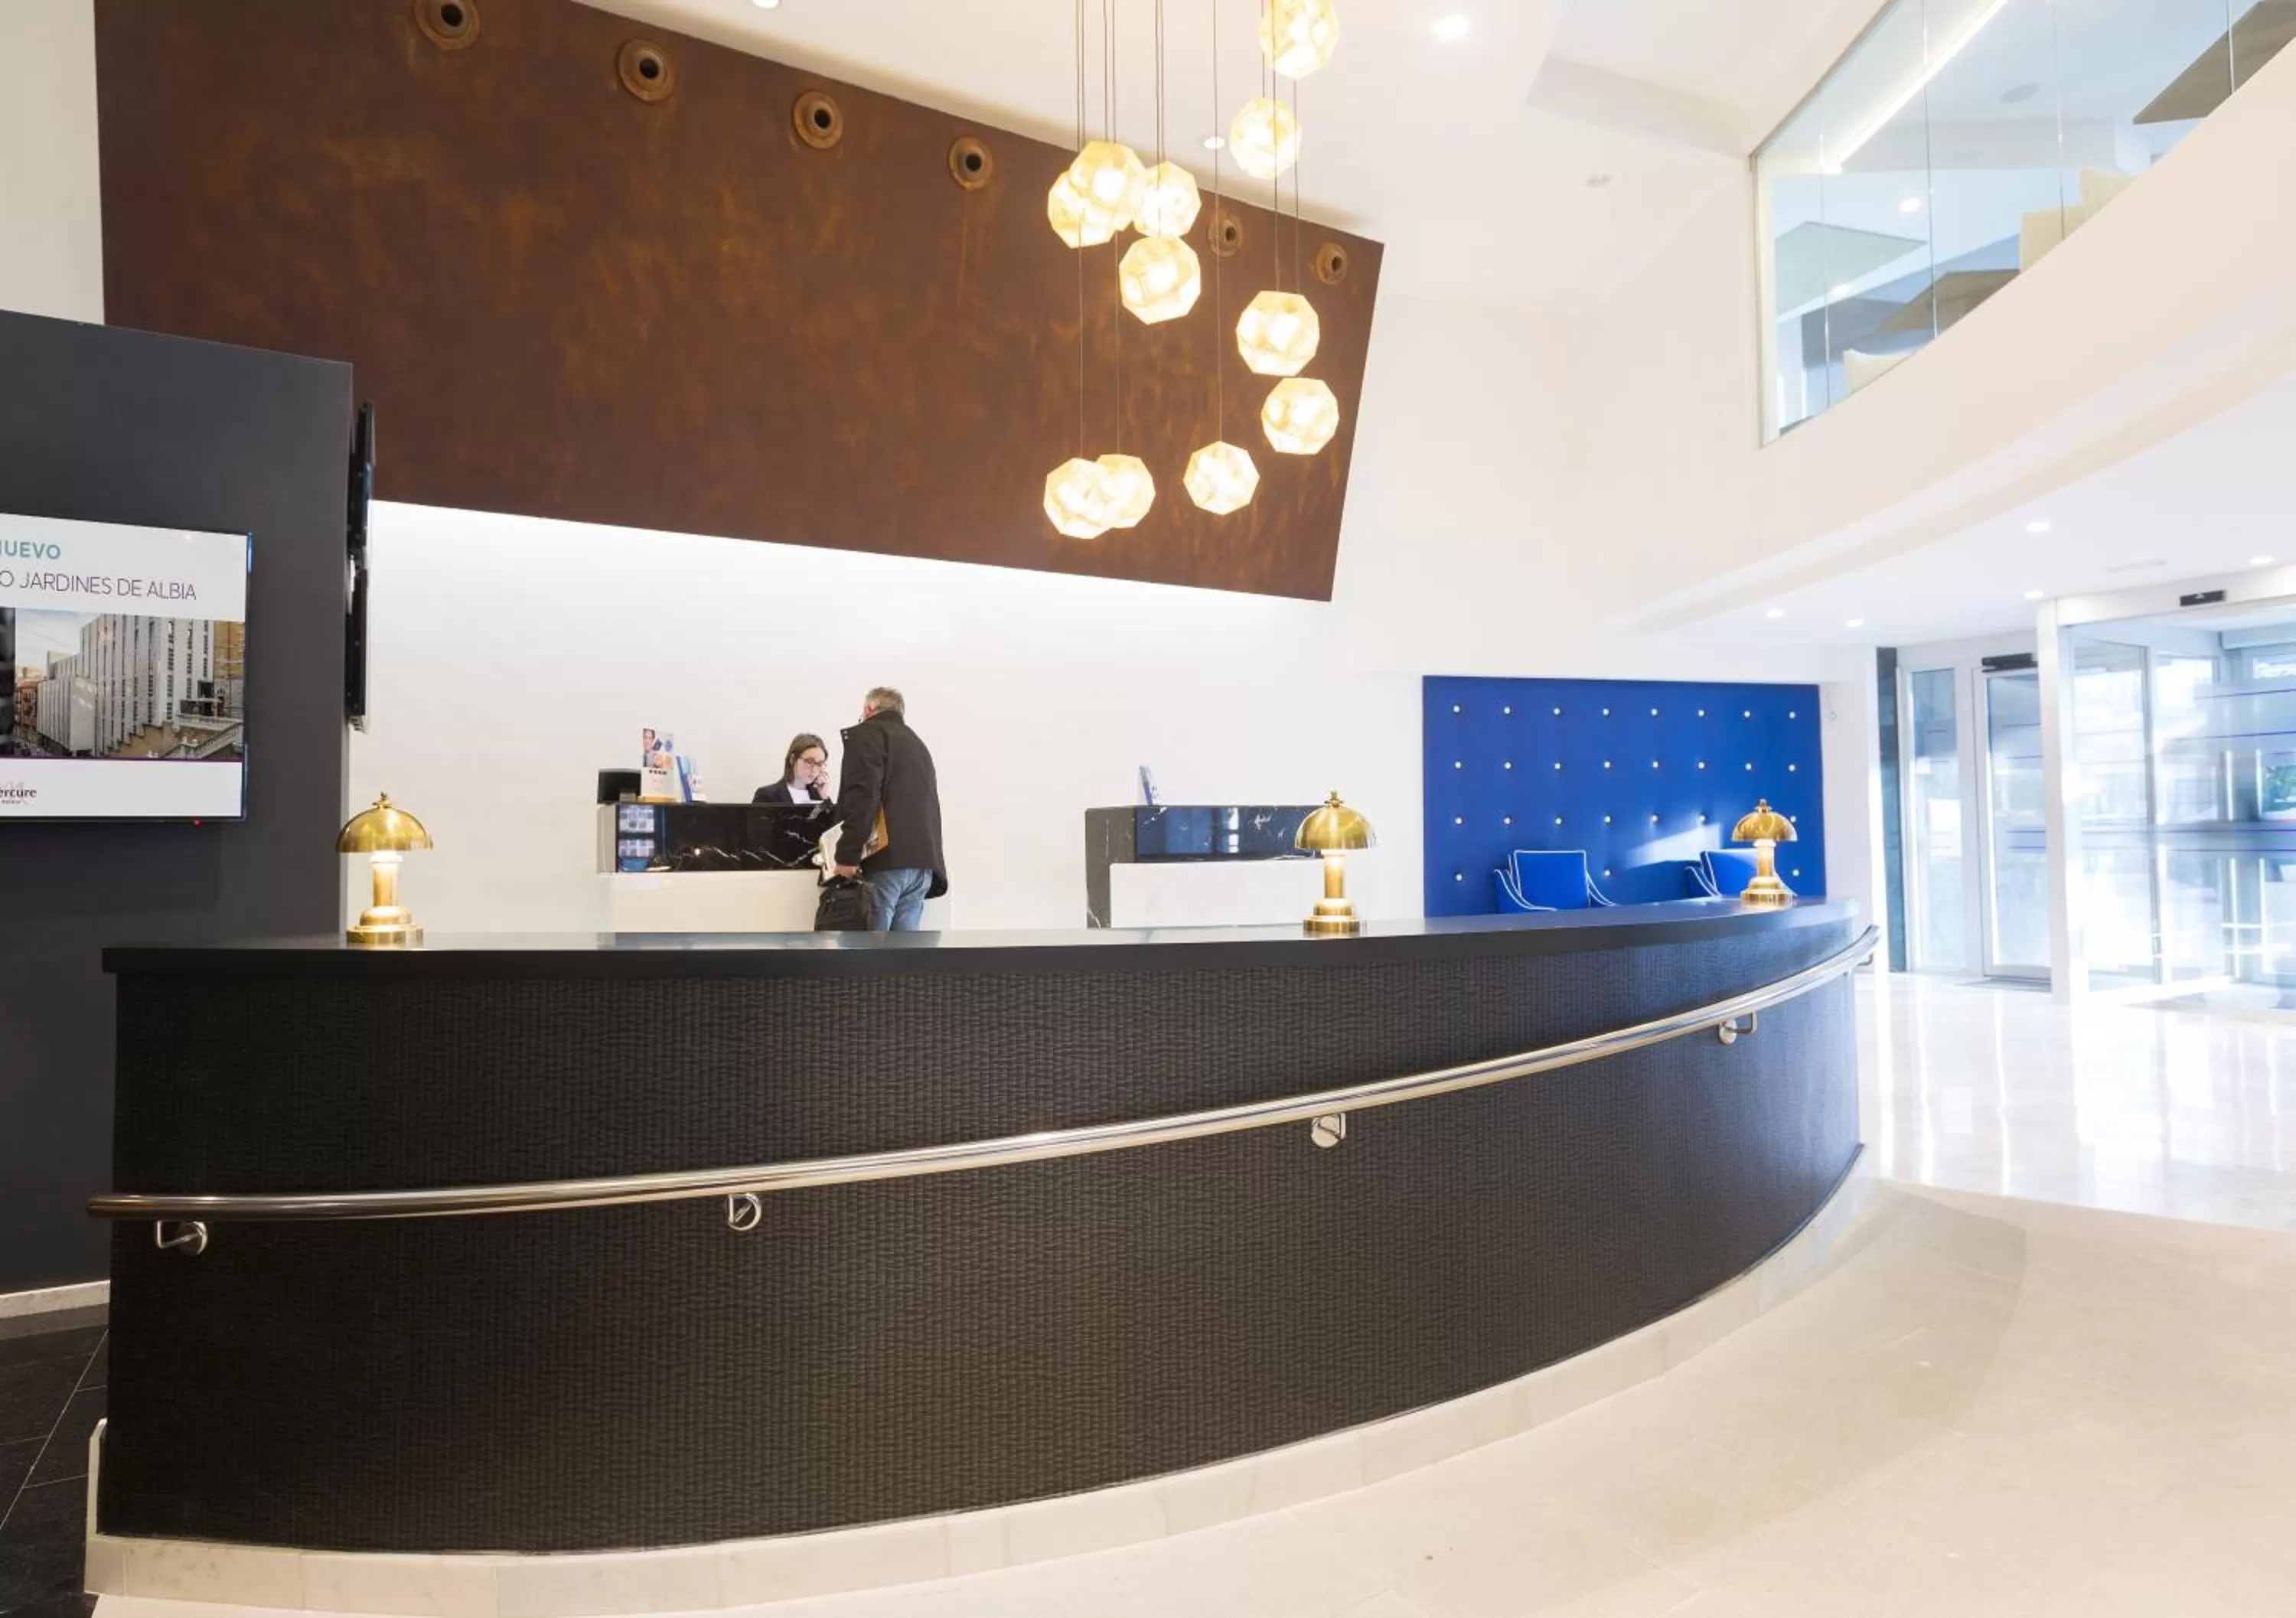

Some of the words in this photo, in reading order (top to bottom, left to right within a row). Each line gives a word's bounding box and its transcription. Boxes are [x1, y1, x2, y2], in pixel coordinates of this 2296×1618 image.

[19, 572, 111, 595] JARDINES
[117, 578, 142, 597] DE
[146, 581, 197, 600] ALBIA
